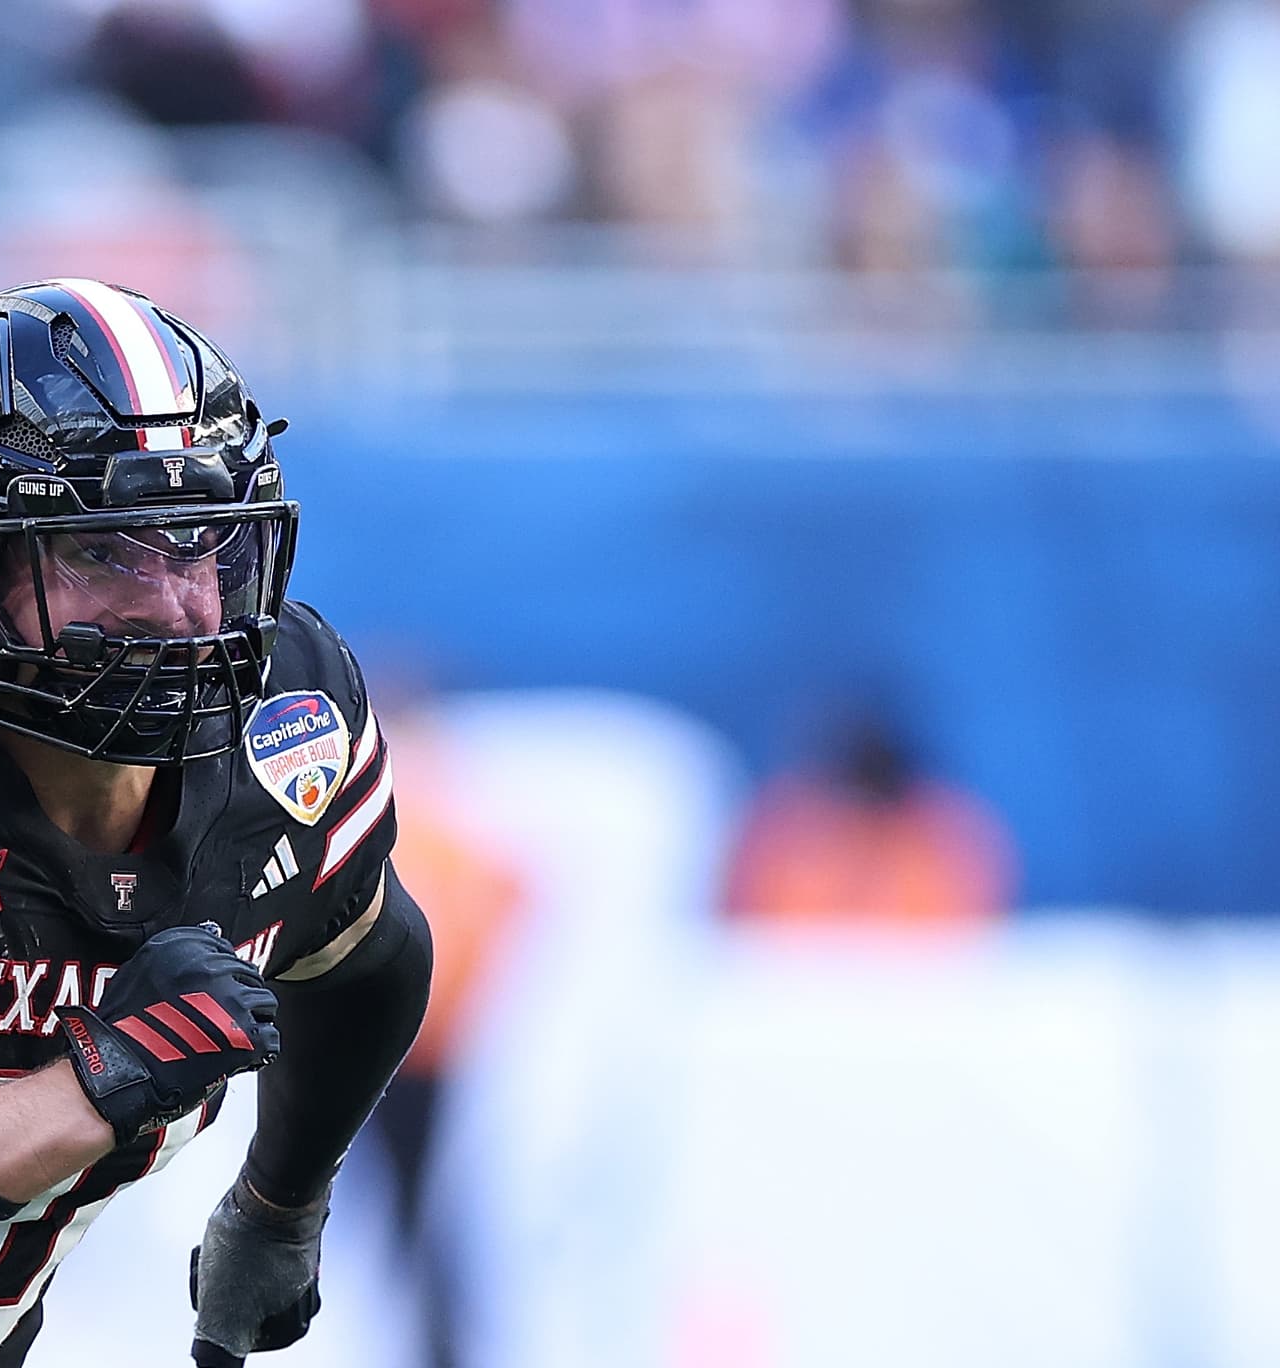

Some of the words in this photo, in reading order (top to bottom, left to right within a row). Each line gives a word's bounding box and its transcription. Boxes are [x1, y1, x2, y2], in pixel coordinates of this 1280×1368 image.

[18, 482, 46, 496] GUNS
[48, 484, 64, 496] UP
[263, 748, 308, 785] ORANGE
[308, 736, 340, 762] BOWL
[64, 1016, 105, 1075] ADIZERO
